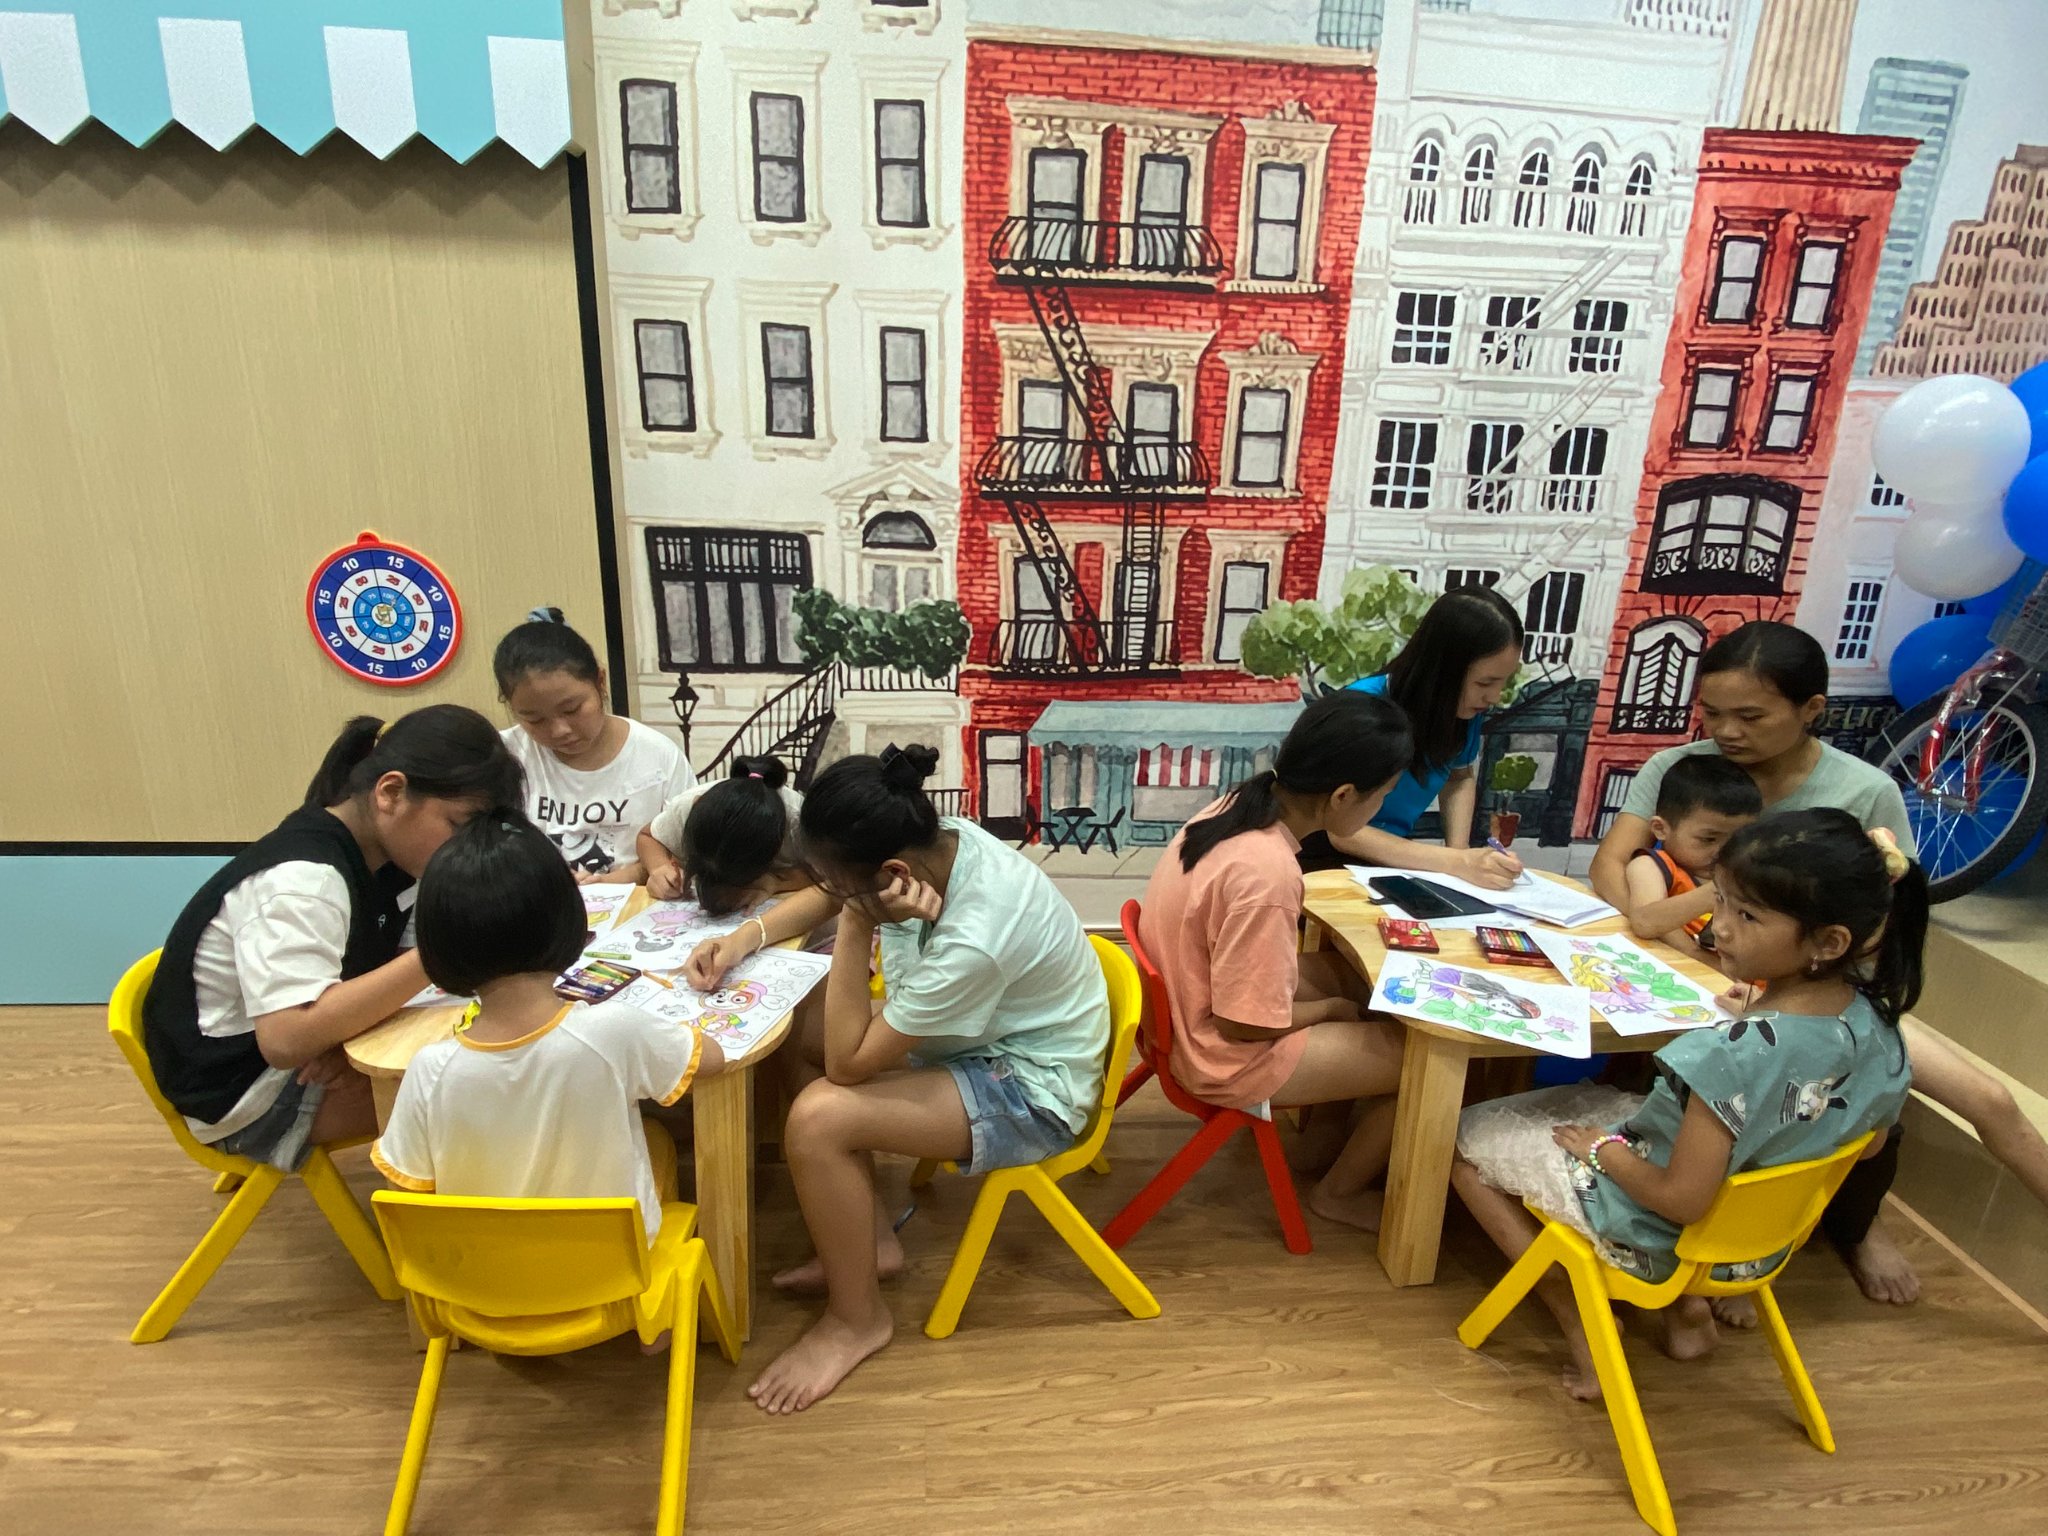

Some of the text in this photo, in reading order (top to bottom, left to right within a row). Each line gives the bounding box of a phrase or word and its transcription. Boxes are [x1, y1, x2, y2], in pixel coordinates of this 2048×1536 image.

[342, 558, 359, 571] 10
[387, 556, 404, 568] 15
[318, 590, 331, 605] 15
[428, 586, 442, 601] 10
[328, 632, 342, 647] 10
[439, 625, 451, 640] 15
[367, 662, 383, 674] 15
[412, 658, 427, 671] 10
[537, 796, 629, 825] ENJOY
